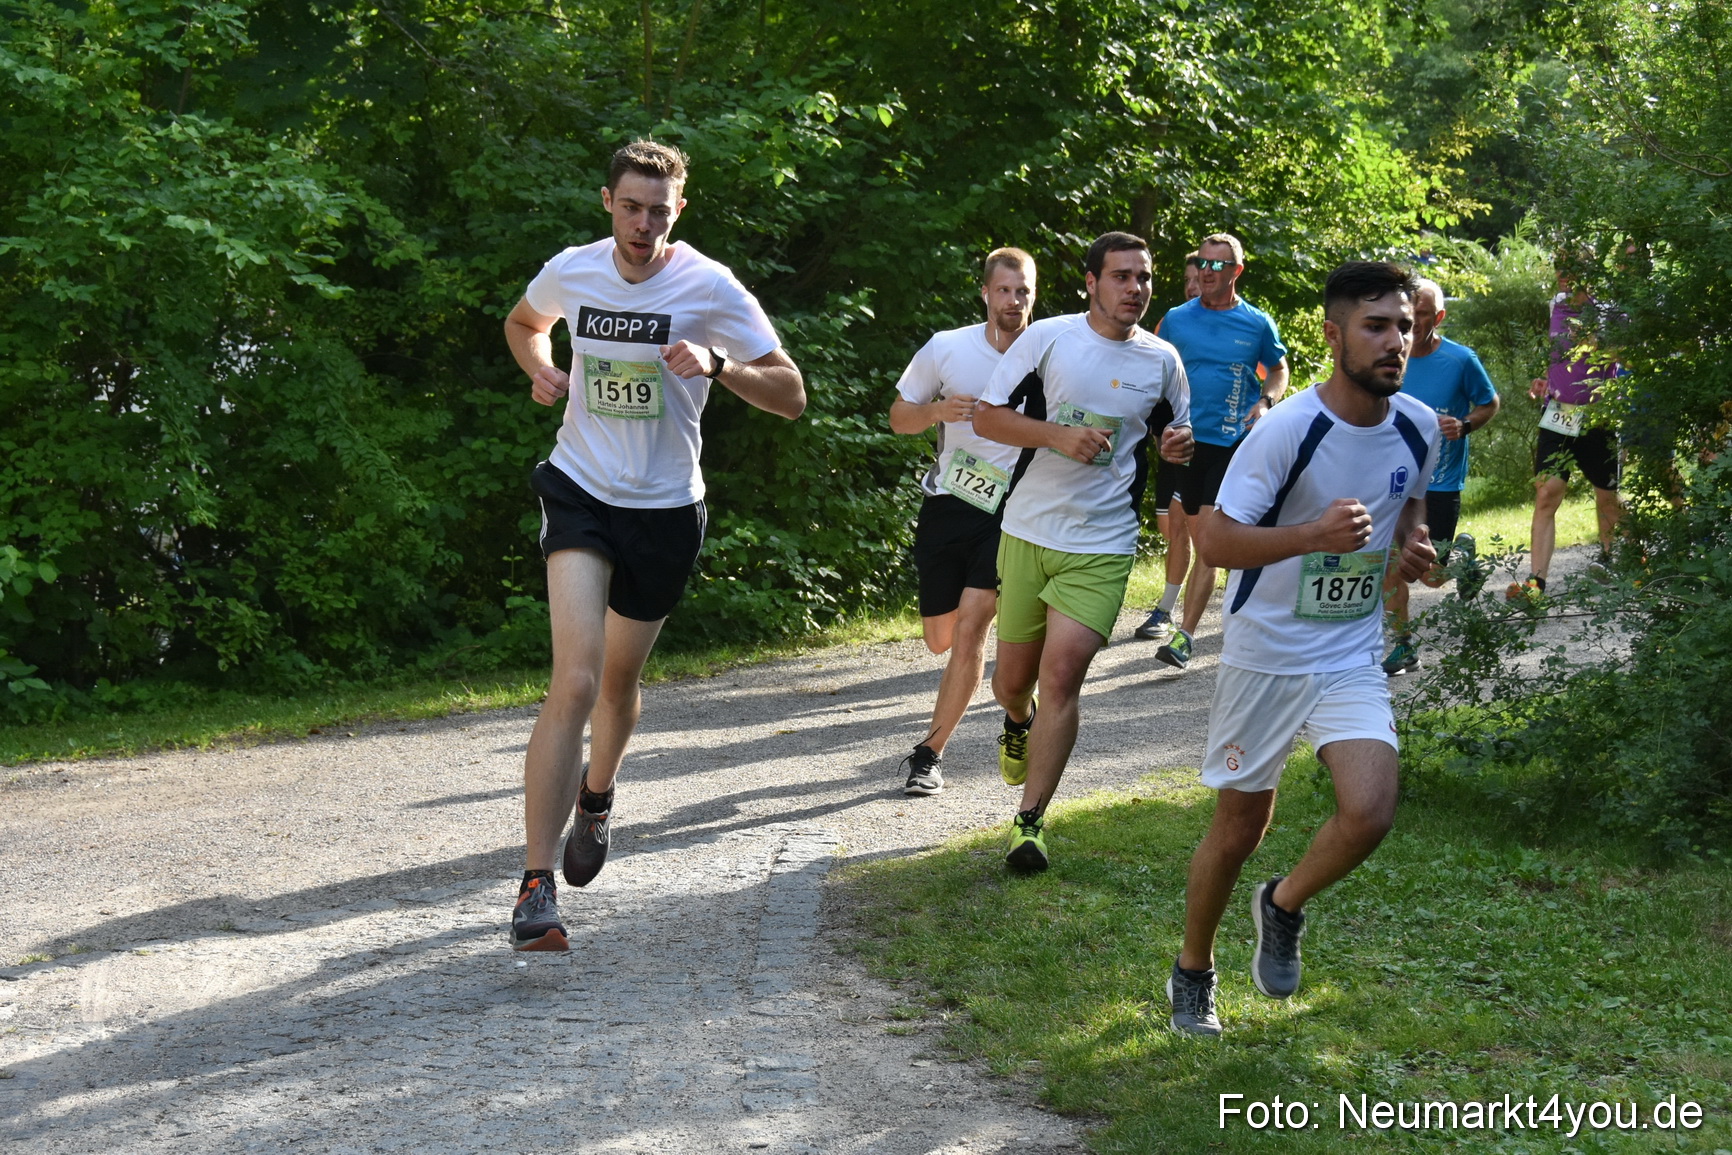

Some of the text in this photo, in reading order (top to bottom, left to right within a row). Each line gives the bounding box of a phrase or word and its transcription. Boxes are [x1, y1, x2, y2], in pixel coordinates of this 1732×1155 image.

[594, 378, 652, 404] 1519
[955, 467, 997, 499] 1724
[1311, 575, 1374, 602] 1876
